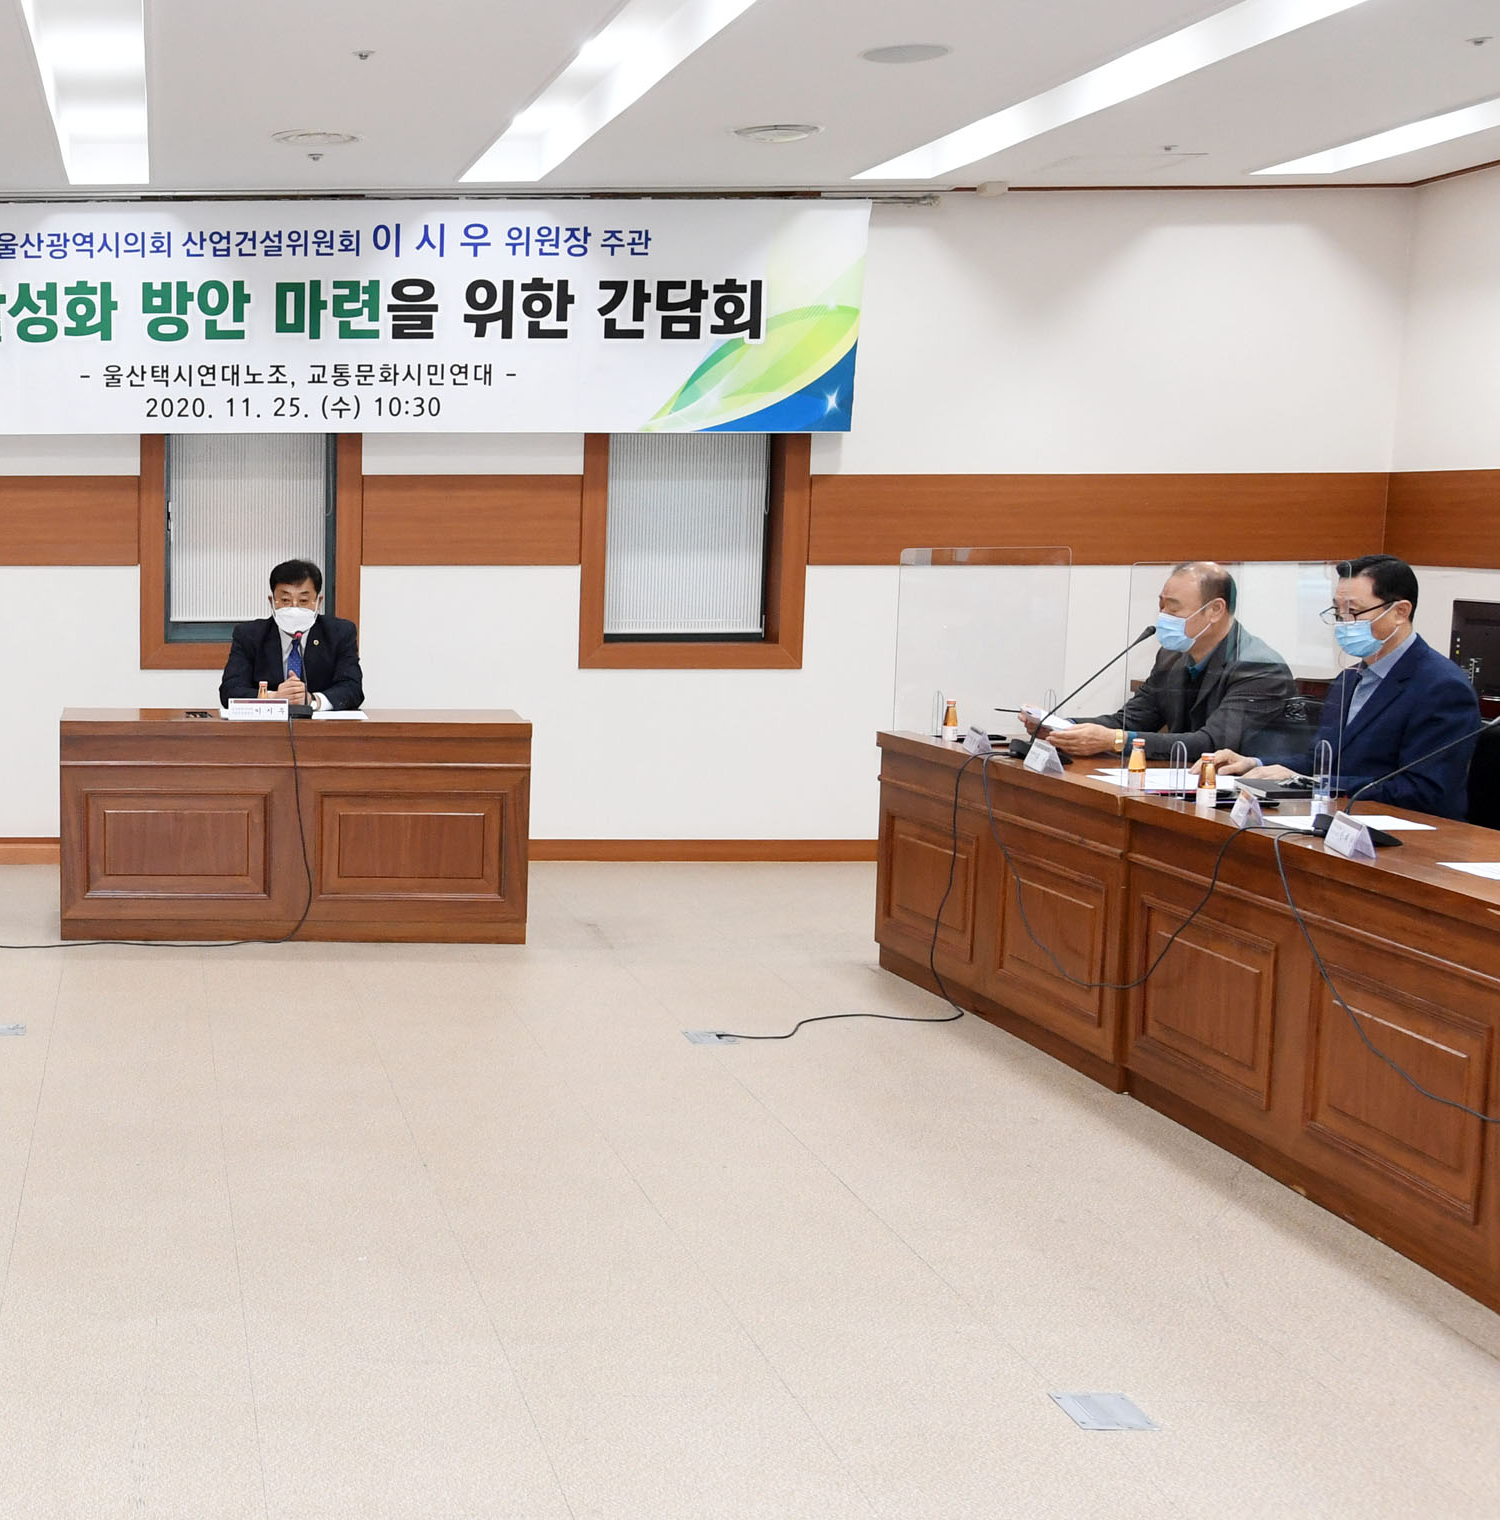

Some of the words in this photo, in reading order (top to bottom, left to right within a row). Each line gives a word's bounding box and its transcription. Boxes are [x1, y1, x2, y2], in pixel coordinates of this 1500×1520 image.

[182, 229, 360, 258] 산업건설위원회
[372, 223, 401, 258] 이
[415, 223, 445, 258] 시
[460, 223, 492, 258] 우
[505, 226, 592, 258] 위원장
[600, 229, 652, 257] 주관
[142, 279, 251, 342] 방안
[275, 279, 440, 341] 마련을
[463, 278, 575, 340] 위한
[596, 277, 764, 340] 간담회
[103, 364, 296, 389] 울산택시연대노조,
[307, 363, 493, 387] 교통문화시민연대
[145, 397, 213, 419] 2020.
[226, 397, 261, 419] 11.
[273, 397, 309, 419] 25.
[321, 395, 361, 420] (수)
[375, 396, 442, 418] 10:30
